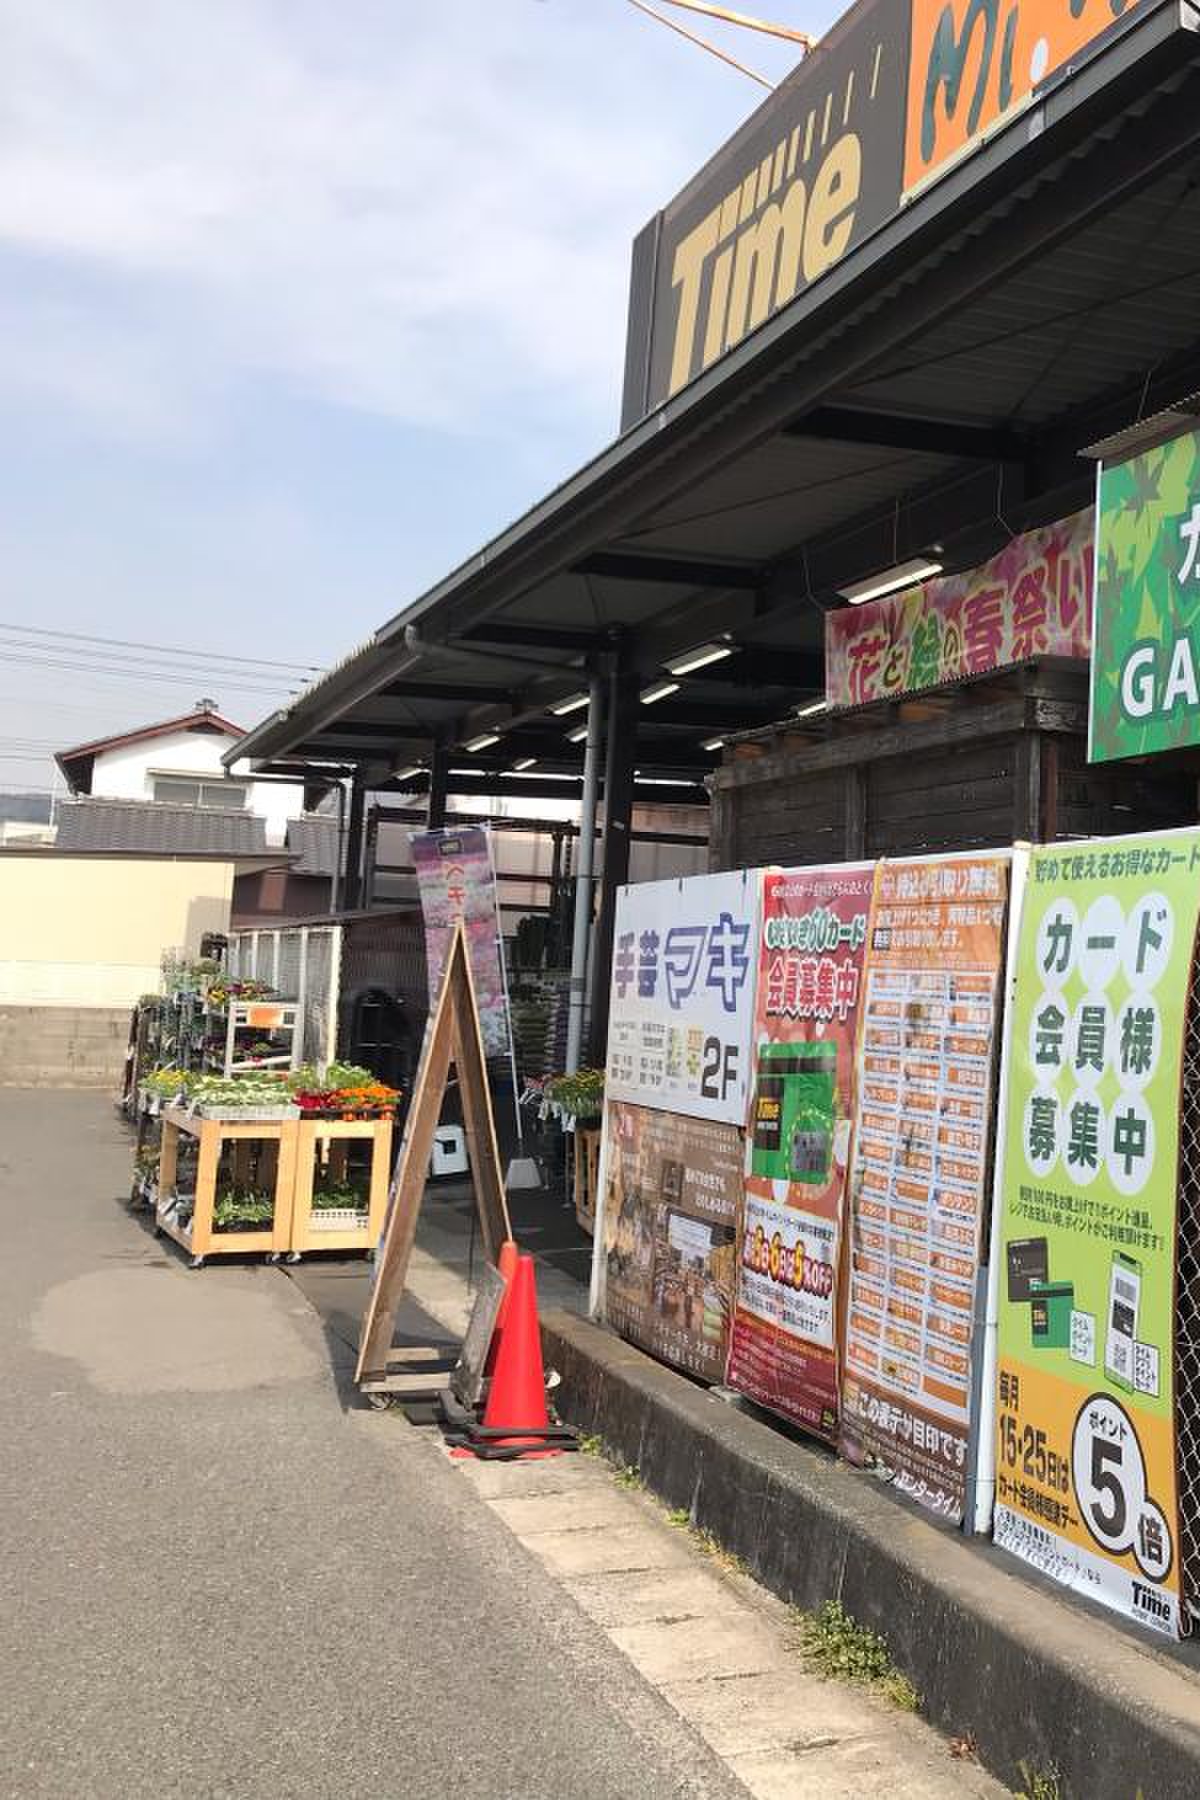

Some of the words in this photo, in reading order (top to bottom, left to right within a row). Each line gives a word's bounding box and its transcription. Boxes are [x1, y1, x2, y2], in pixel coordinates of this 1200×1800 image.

[669, 130, 864, 399] Time
[614, 911, 751, 1013] 手芸マキ
[1043, 908, 1168, 974] カード
[767, 957, 859, 1021] 会員募集中
[700, 1034, 739, 1101] 2F
[1035, 1004, 1156, 1075] 会員様
[1029, 1096, 1148, 1176] 募集中
[1089, 1411, 1128, 1441] ポイント
[1089, 1435, 1128, 1538] 5
[1136, 1513, 1163, 1566] 倍
[1131, 1581, 1171, 1621] Time
